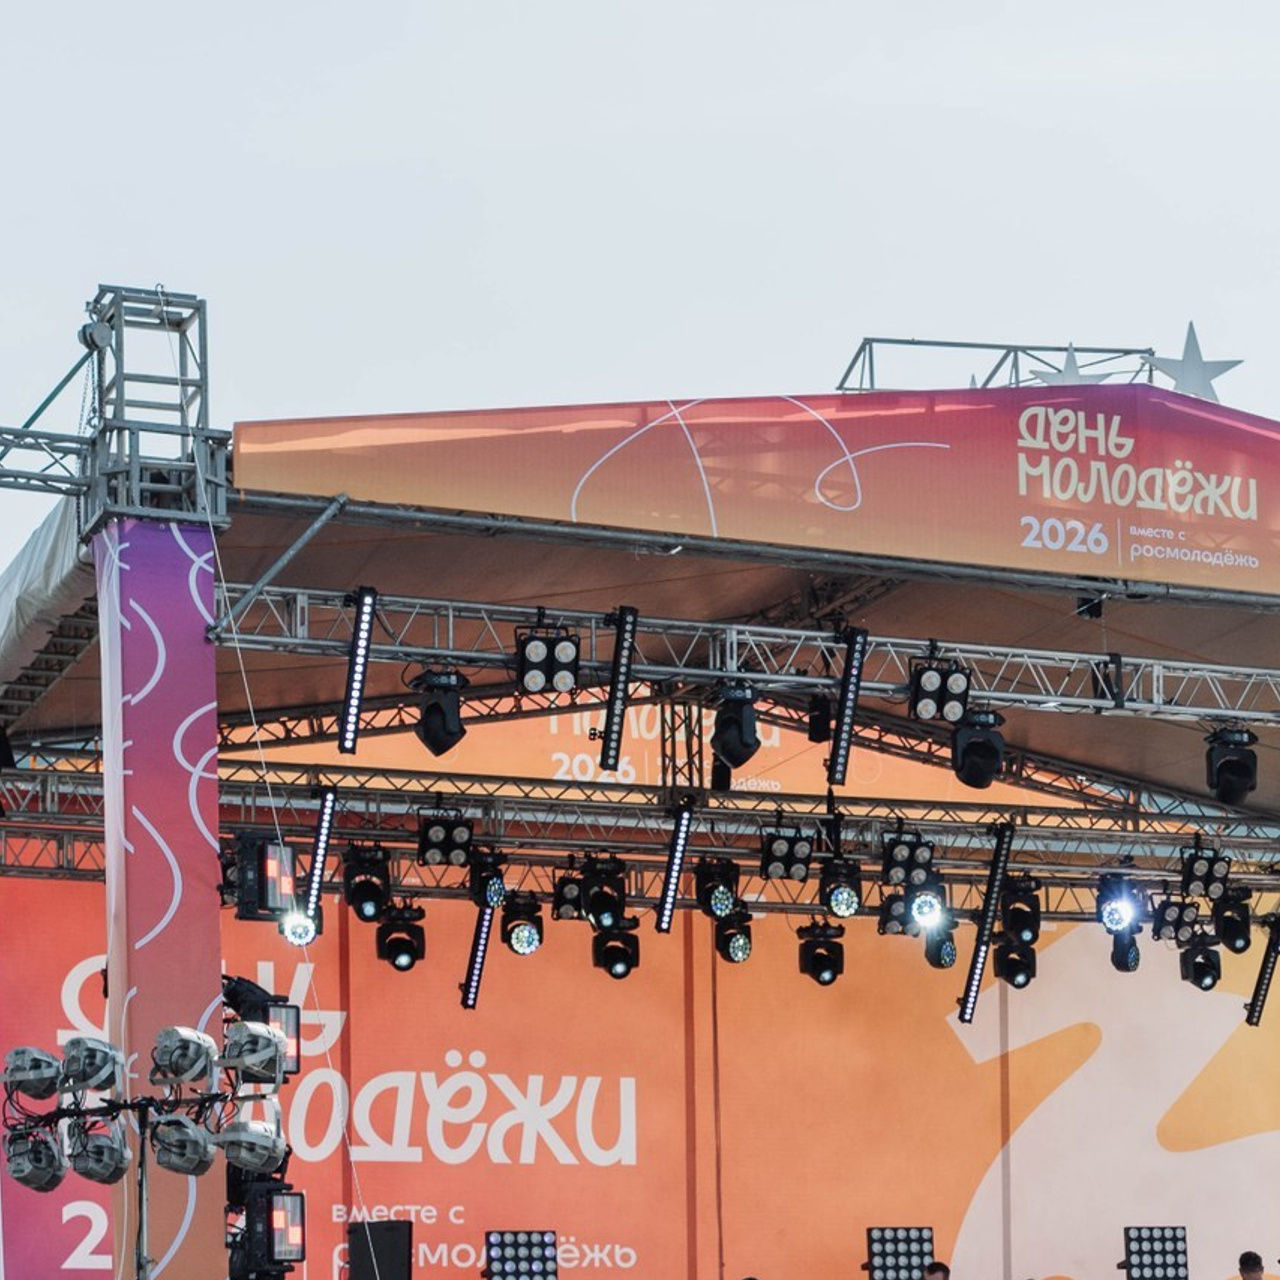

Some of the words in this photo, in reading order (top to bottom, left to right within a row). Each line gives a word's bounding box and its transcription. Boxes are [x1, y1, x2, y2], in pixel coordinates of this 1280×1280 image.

[1019, 515, 1109, 554] 2026
[1129, 525, 1174, 540] вместе
[1178, 529, 1186, 541] с
[1130, 542, 1259, 569] росмолодёжь
[332, 1203, 437, 1224] вместе
[449, 1206, 465, 1224] с
